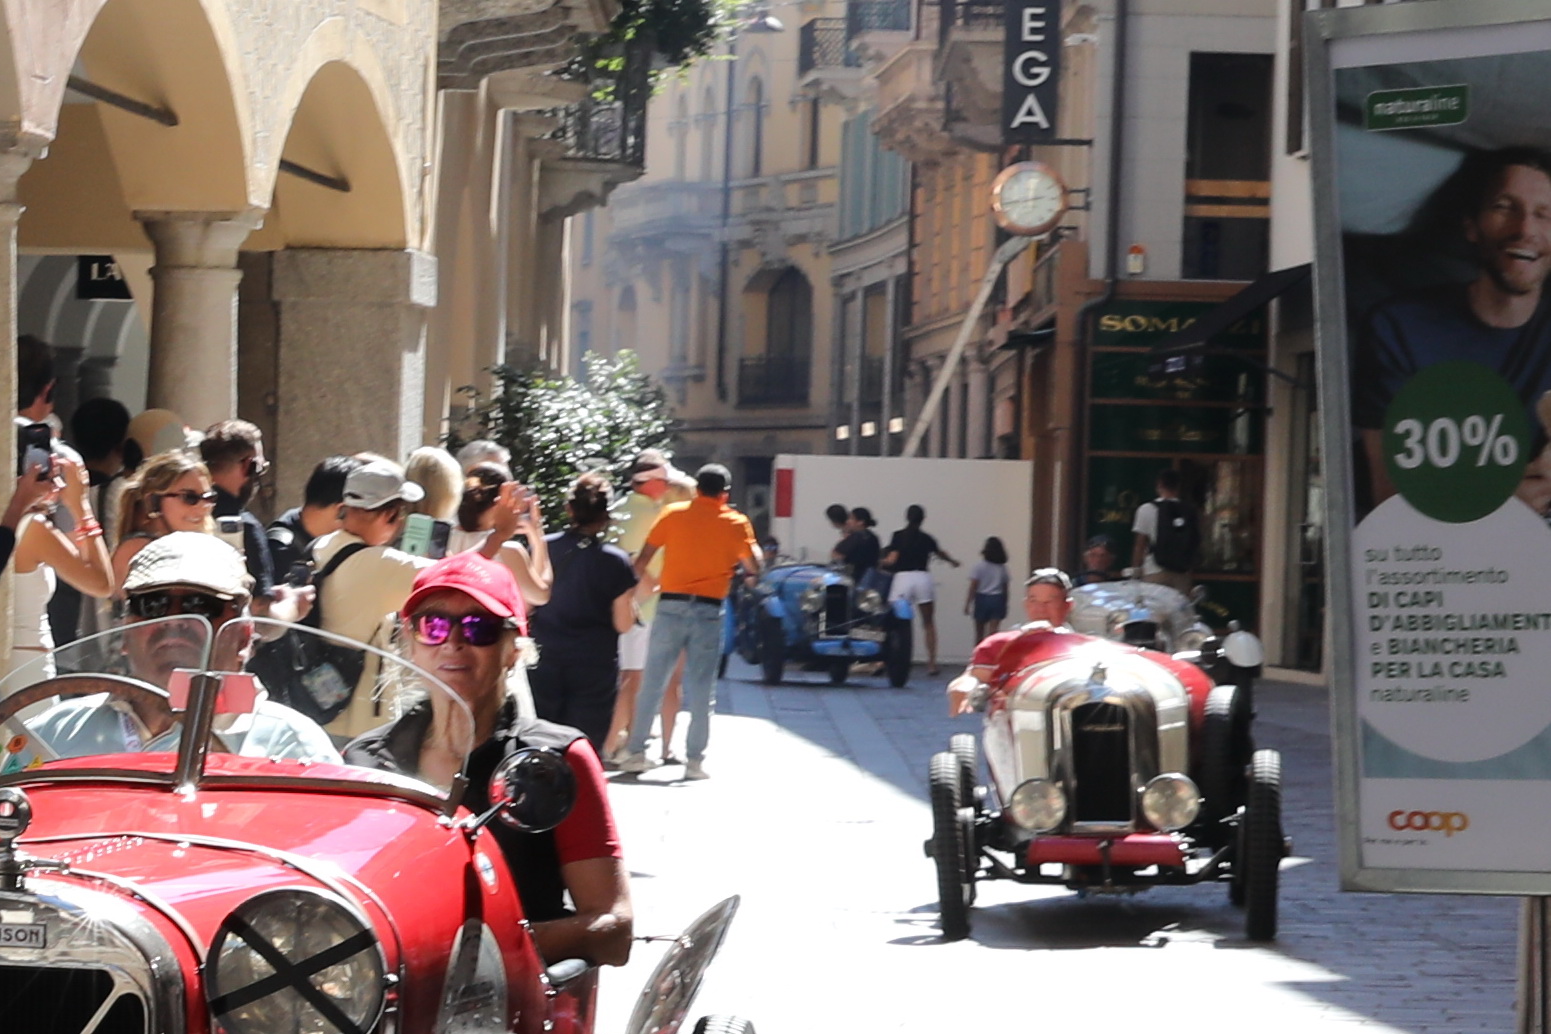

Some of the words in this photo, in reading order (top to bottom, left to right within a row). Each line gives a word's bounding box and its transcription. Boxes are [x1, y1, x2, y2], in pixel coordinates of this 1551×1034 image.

[1393, 414, 1519, 469] 30%
[1364, 548, 1389, 563] su
[1392, 544, 1443, 562] tutto
[1365, 566, 1509, 585] l'assortimento
[1368, 591, 1389, 609] DI
[1394, 590, 1444, 608] CAPI
[1371, 642, 1383, 655] e
[1386, 637, 1521, 655] BIANCHERIA
[1371, 661, 1410, 678] PER
[1416, 661, 1445, 678] LA
[1448, 661, 1508, 678] CASA
[1371, 684, 1470, 702] naturaline
[1388, 809, 1470, 837] coop
